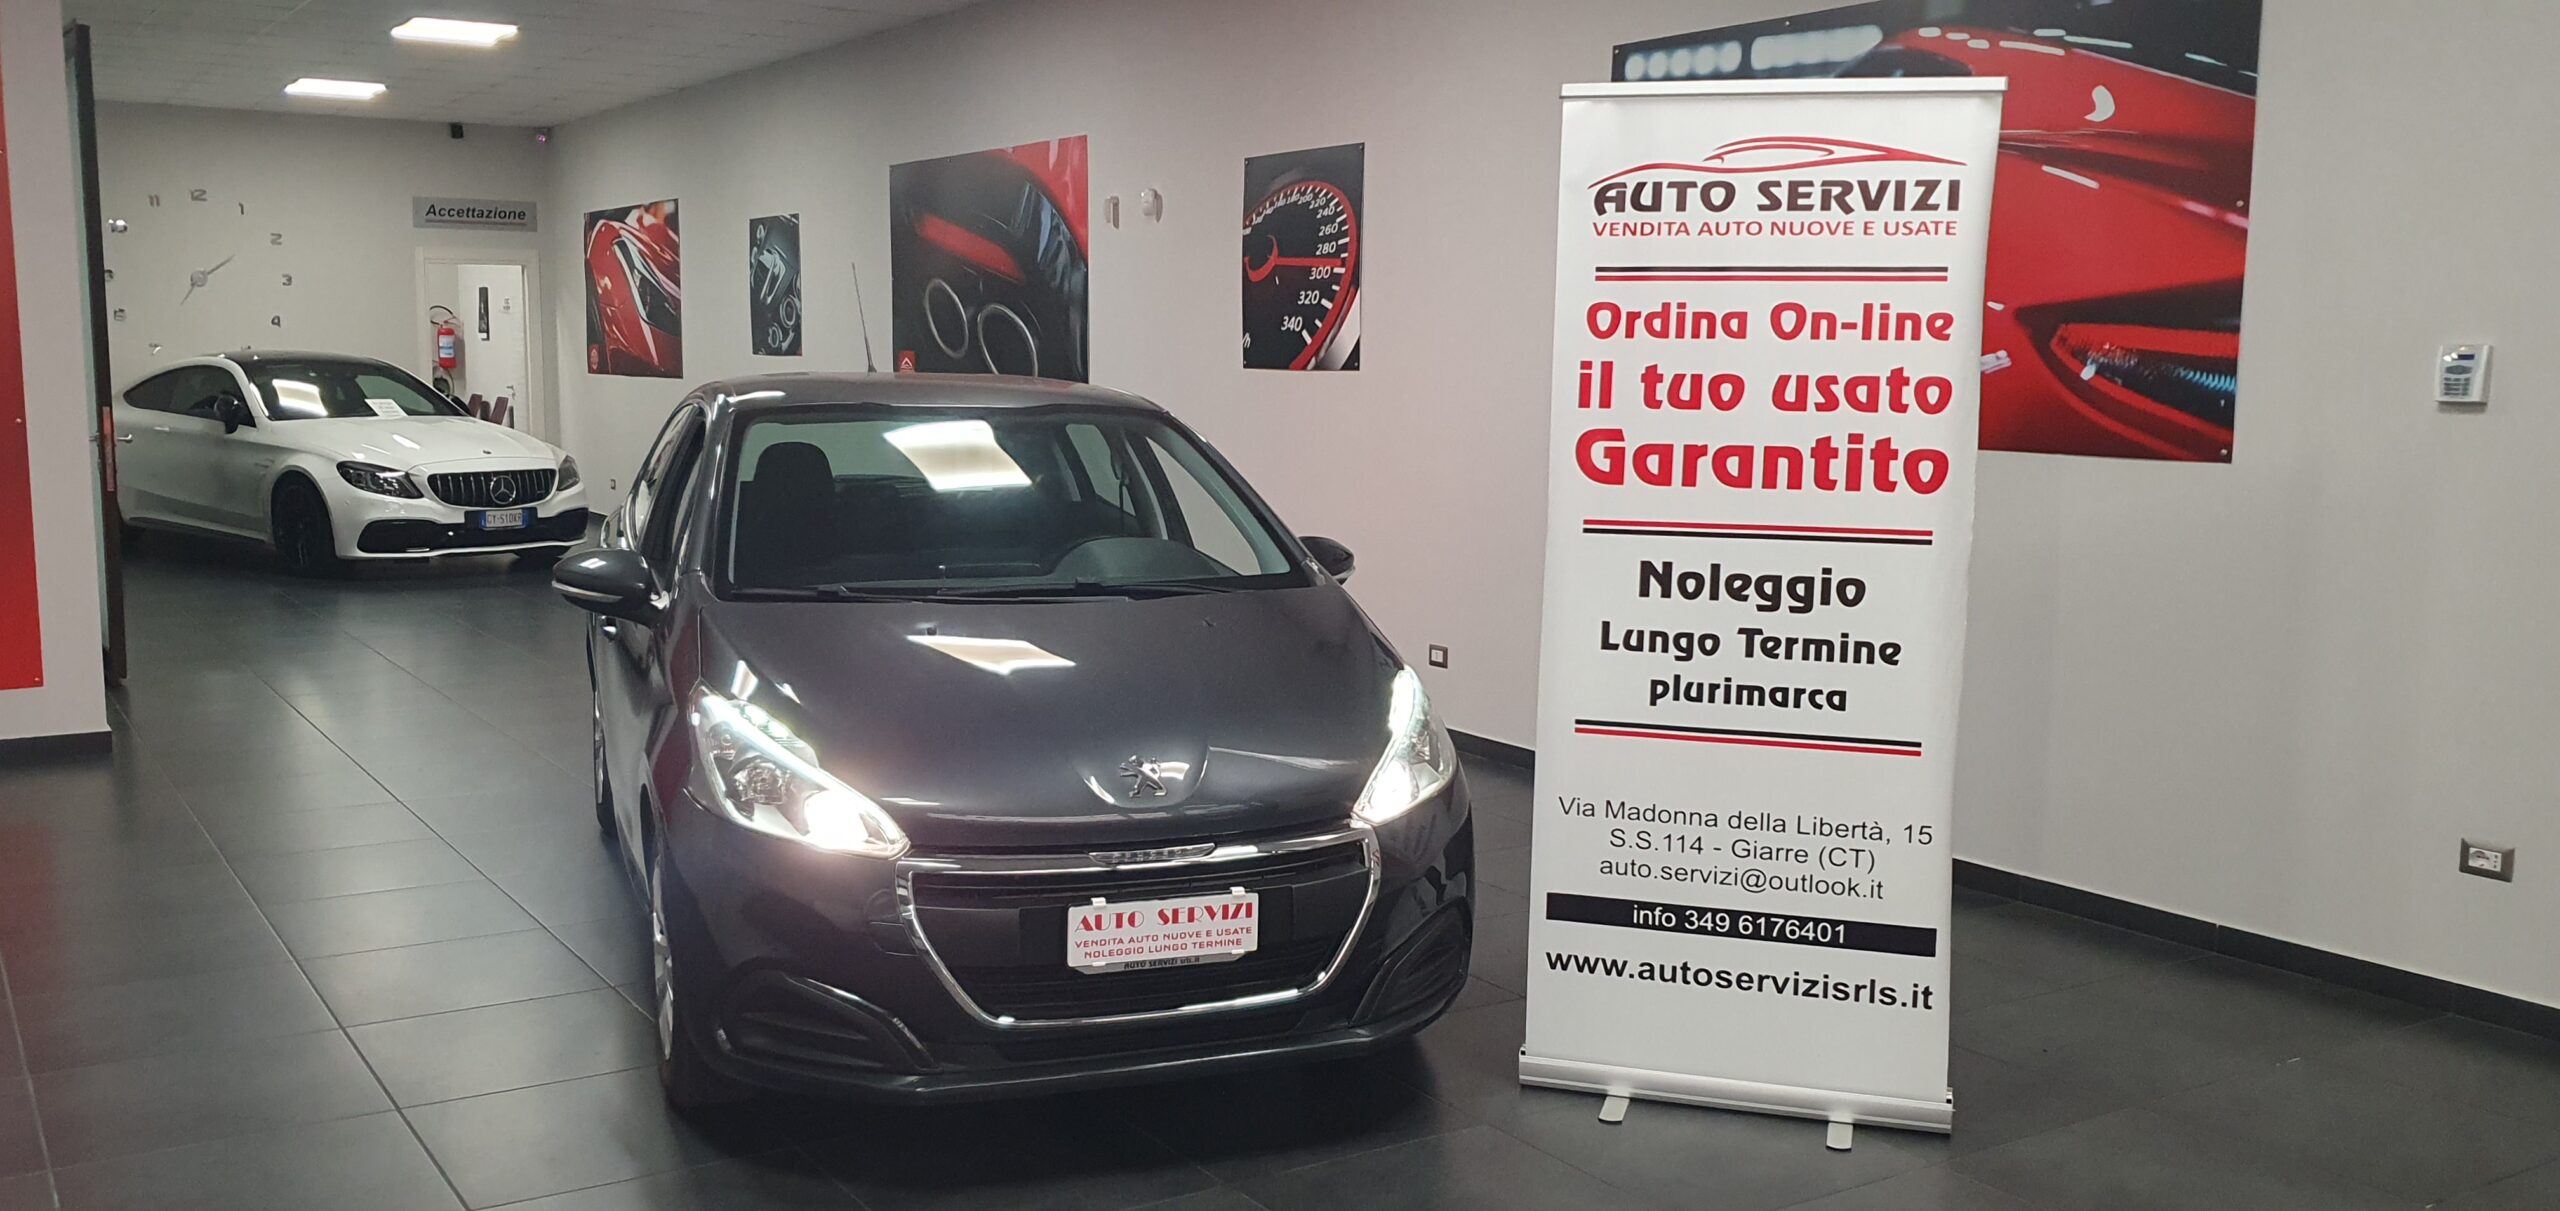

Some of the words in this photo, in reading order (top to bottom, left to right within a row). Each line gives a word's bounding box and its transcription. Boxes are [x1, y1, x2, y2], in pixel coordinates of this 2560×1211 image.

[148, 194, 161, 207] 11
[189, 189, 207, 202] 12
[1297, 192, 1313, 205] 200
[1308, 196, 1326, 209] 220
[1593, 180, 1736, 217] AUTO
[1757, 179, 1960, 215] SERVIZI
[238, 202, 245, 215] 1
[425, 204, 527, 221] Accettazione
[1316, 205, 1335, 218] 240
[1318, 222, 1339, 236] 260
[1593, 221, 1690, 237] VENDITA
[1697, 221, 1763, 236] AUTO
[1770, 221, 1854, 236] NUOVE
[1863, 221, 1874, 236] E
[1884, 221, 1957, 236] USATE
[270, 232, 283, 246] 2
[1315, 241, 1337, 255] 280
[281, 273, 293, 286] 3
[1309, 266, 1331, 279] 300
[1297, 290, 1320, 304] 320
[270, 315, 282, 328] 4
[1281, 315, 1303, 331] 340
[1587, 301, 1748, 341] Ordina
[1770, 302, 1954, 341] On-line
[1579, 360, 1614, 410] il
[1641, 363, 1746, 412] tuo
[1771, 366, 1953, 415] usato
[1575, 428, 1950, 495] Garantito
[1638, 560, 1867, 616] Noleggio
[1600, 621, 1721, 662] Lungo
[1737, 627, 1902, 666] Termine
[1649, 674, 1848, 711] plurimarca
[1558, 797, 1595, 819] Via
[1605, 800, 1718, 828] Madonna
[1728, 810, 1786, 834] della
[1796, 815, 1891, 846] Libertà,
[1903, 825, 1933, 846] 15
[1609, 828, 1705, 856] S.S.114
[1731, 838, 1809, 865] Giarre
[1818, 846, 1875, 875] (CT)
[1599, 858, 1884, 900] auto.servizi@outlook.it
[1074, 910, 1145, 933] AUTO
[1156, 902, 1253, 926] SERVIZI
[1632, 905, 1676, 928] info
[1684, 908, 1731, 933] 349
[1738, 913, 1846, 944] 6176401
[1075, 937, 1125, 948] VENDITA
[1127, 934, 1159, 945] AUTO
[1163, 931, 1202, 941] NUOVE
[1205, 929, 1213, 937] E
[1216, 926, 1253, 937] USATE
[1084, 946, 1145, 959] NOLEGGIO
[1148, 943, 1188, 954] LUNGO
[1191, 938, 1243, 949] TERMINE
[1123, 960, 1147, 970] AUTO
[1148, 957, 1179, 968] SERVIZI
[1545, 951, 1935, 1011] www.autoservizisrls.it
